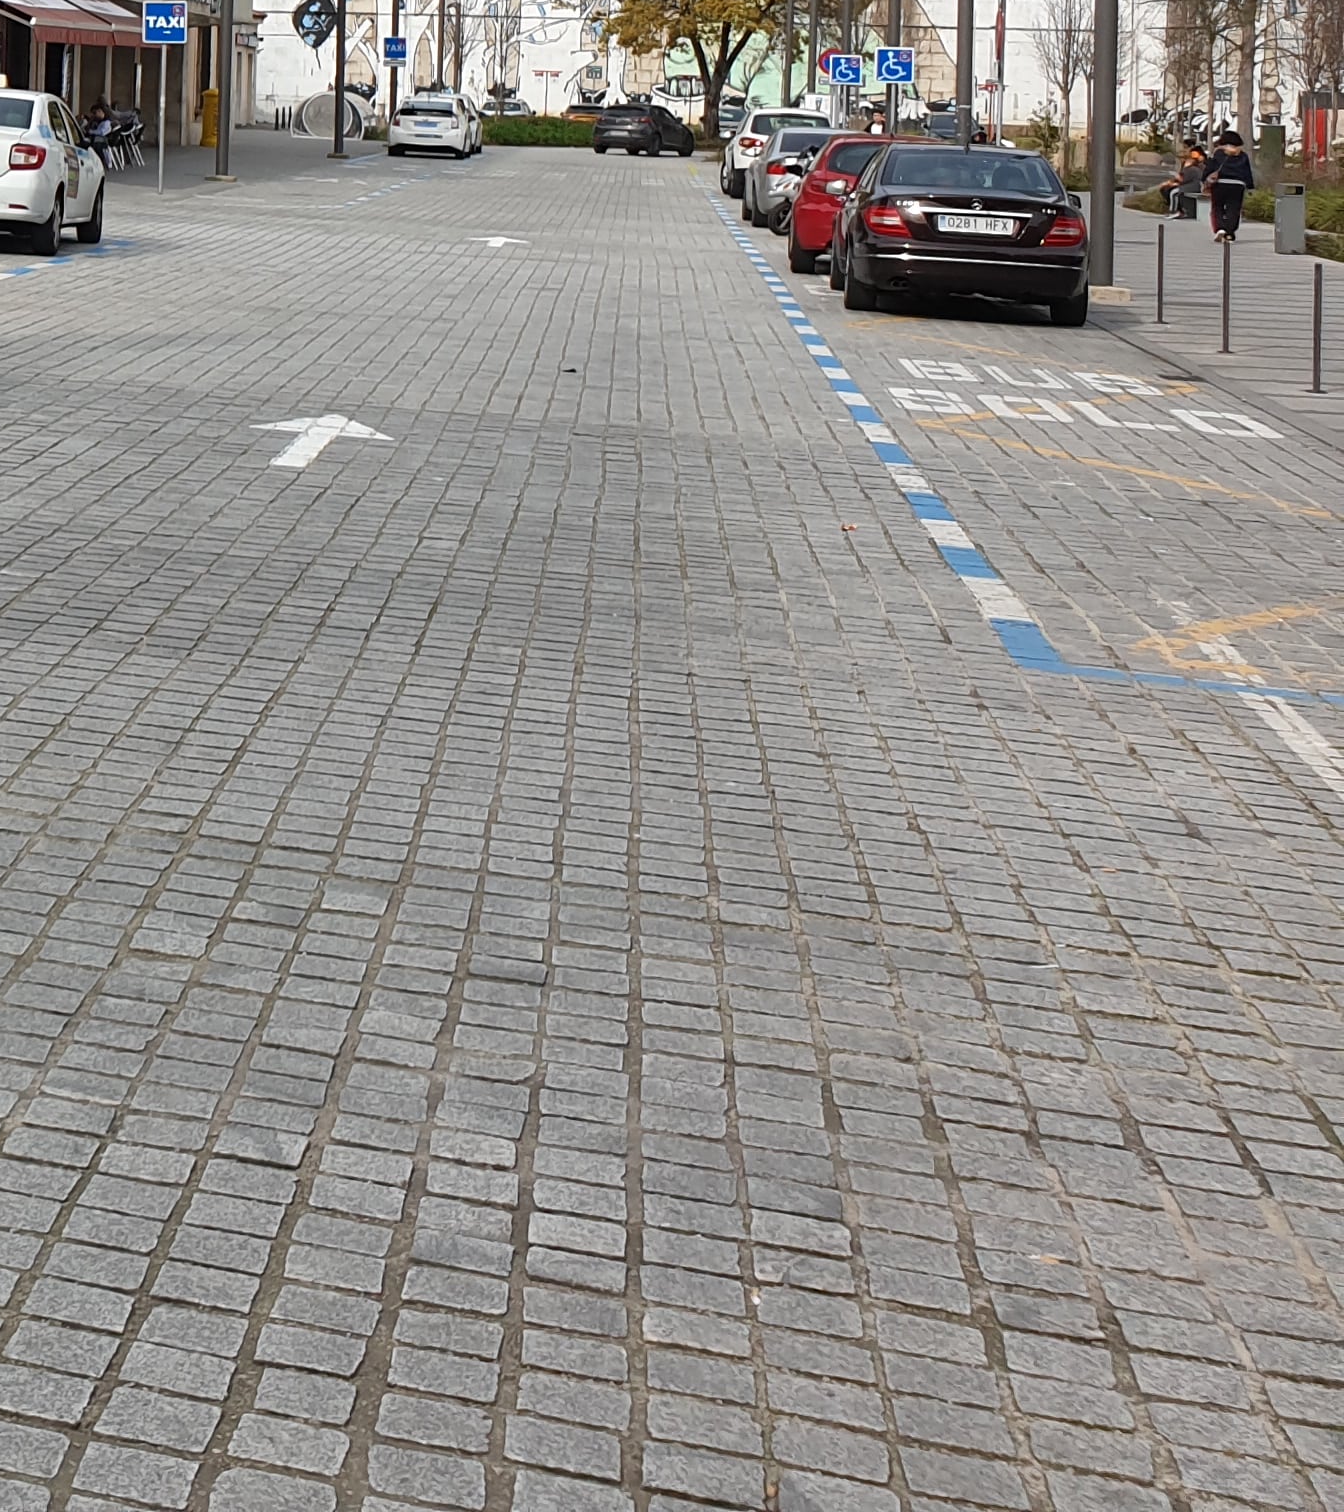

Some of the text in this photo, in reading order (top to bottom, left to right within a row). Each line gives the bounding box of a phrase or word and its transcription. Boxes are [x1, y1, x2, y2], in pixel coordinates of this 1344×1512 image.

[146, 16, 185, 28] TAXI
[385, 43, 406, 52] TAXI
[947, 217, 1009, 231] 0281 HFX
[898, 357, 1165, 397] BUS
[887, 388, 1284, 439] SOLO
